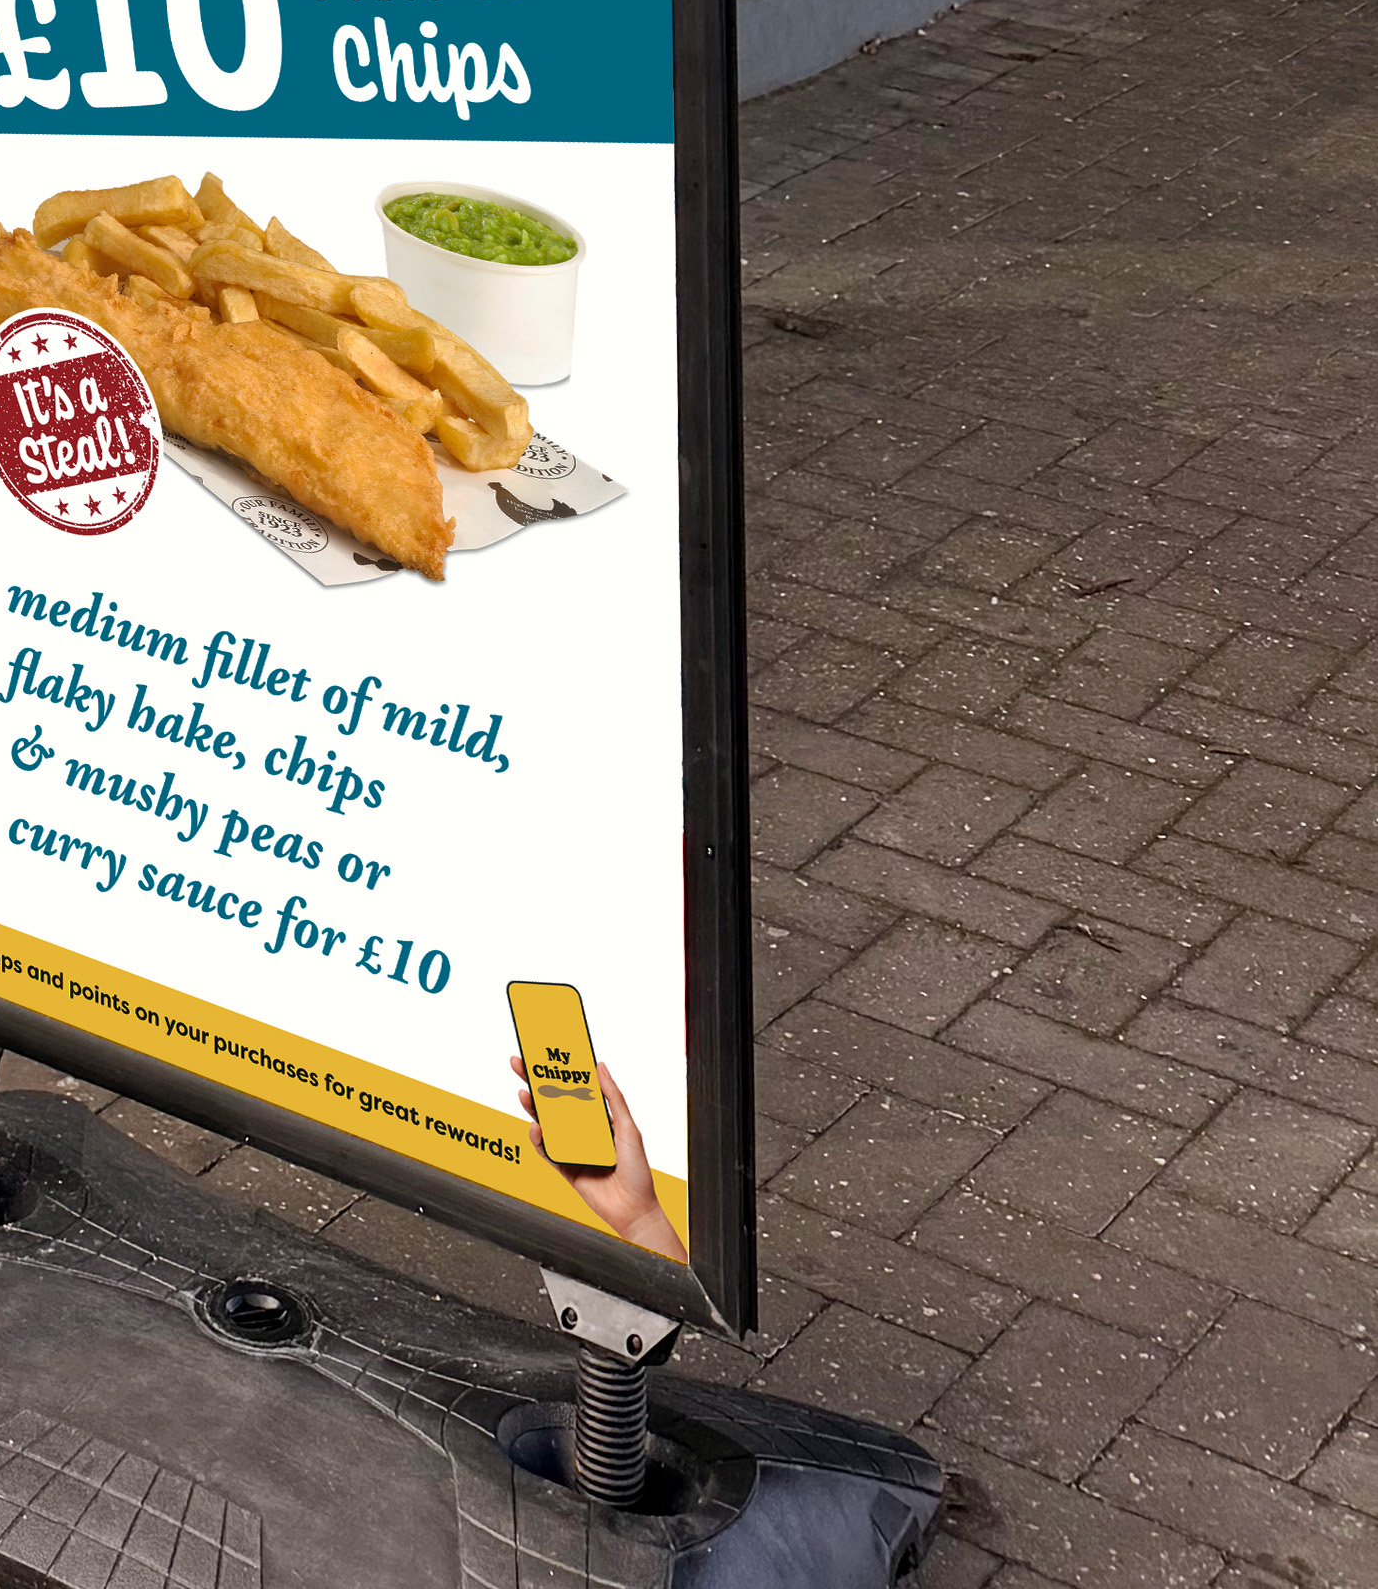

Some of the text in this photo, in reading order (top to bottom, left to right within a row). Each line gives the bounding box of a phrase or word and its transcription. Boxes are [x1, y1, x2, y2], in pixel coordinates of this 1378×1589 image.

[331, 16, 532, 121] Chips
[12, 375, 109, 428] It's a
[17, 415, 137, 485] Steal!
[239, 498, 323, 537] OUR FAMILY
[257, 510, 303, 530] SINCE
[259, 517, 303, 538] 1923
[7, 584, 511, 774] medium fillet of mild,
[126, 684, 246, 770] hake,
[263, 735, 386, 815] chips
[10, 725, 392, 891] & mushy peas or
[8, 818, 452, 996] curry sauce for £10
[26, 962, 64, 991] and
[68, 979, 131, 1016] points
[134, 1005, 160, 1027] on
[163, 1015, 210, 1045] your
[213, 1035, 320, 1088] purchases
[323, 1072, 356, 1101] for
[358, 1088, 421, 1127] great
[424, 1114, 522, 1165] rewards!
[531, 1064, 592, 1085] Chippy
[545, 1046, 572, 1066] My
